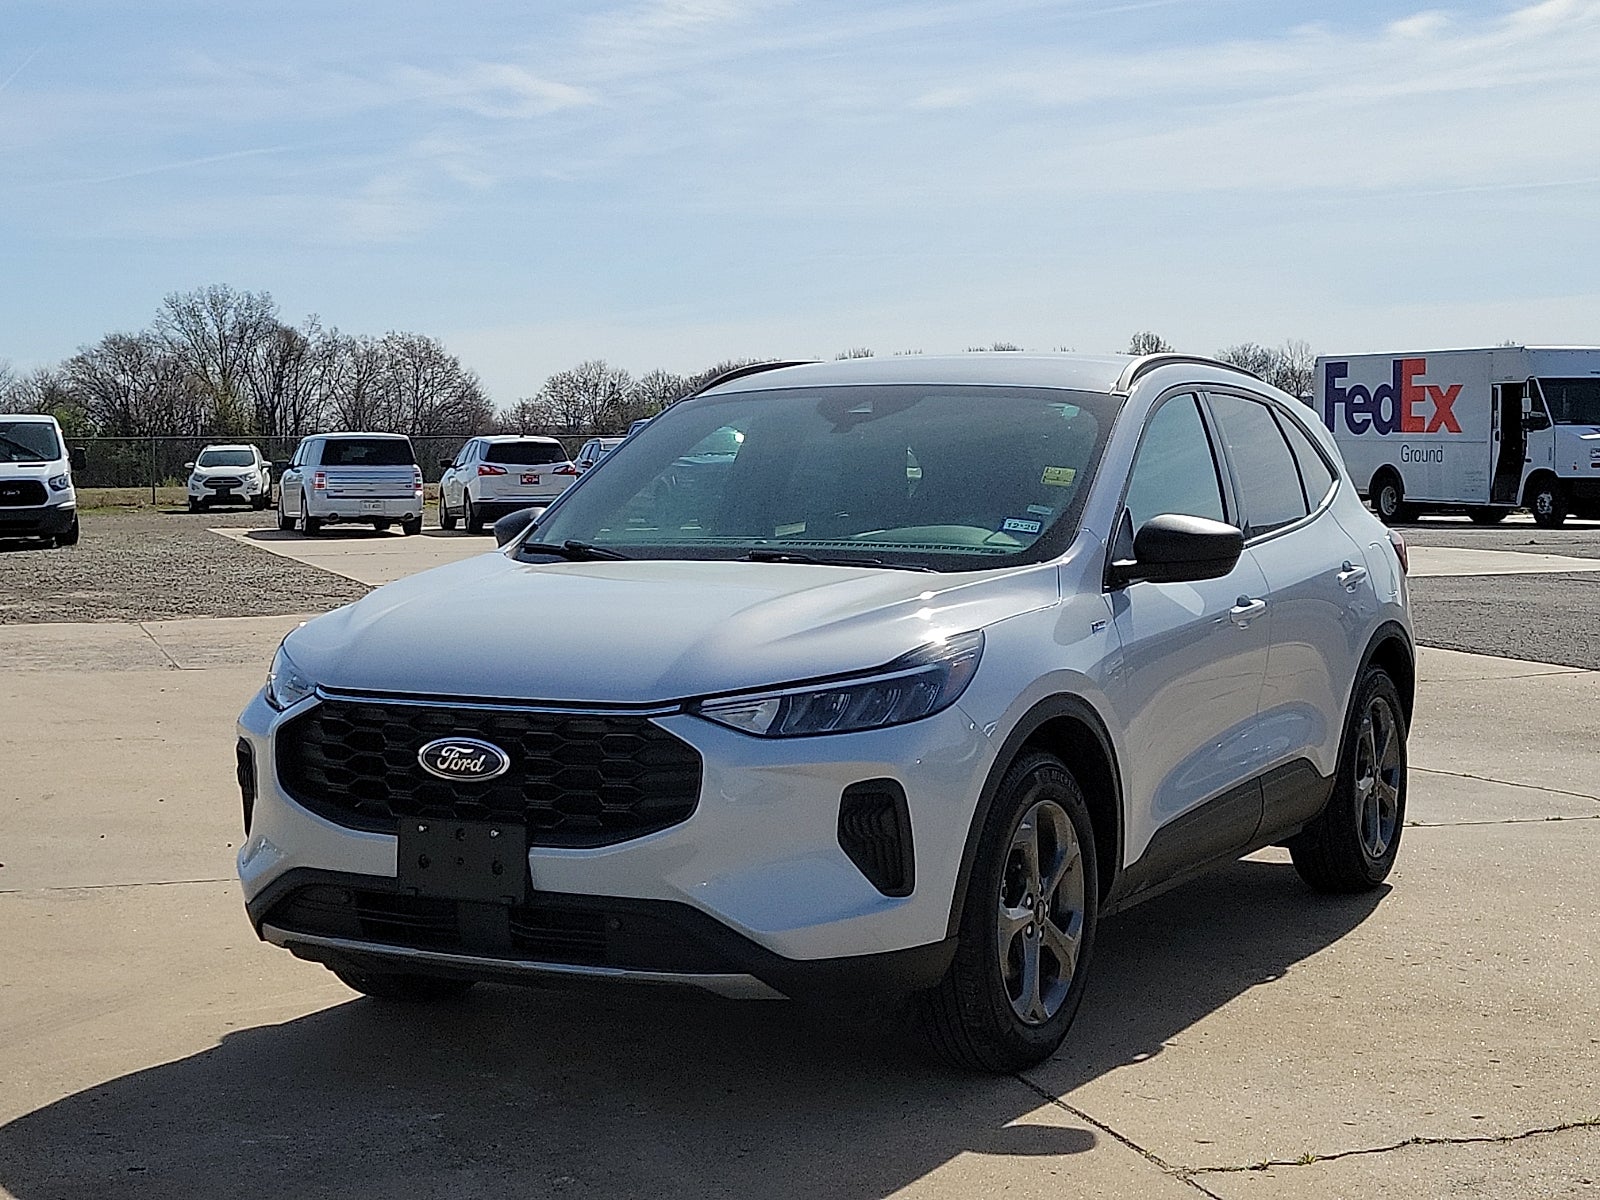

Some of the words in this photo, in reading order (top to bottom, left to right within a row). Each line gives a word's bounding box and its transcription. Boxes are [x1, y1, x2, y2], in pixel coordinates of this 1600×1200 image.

[1325, 358, 1463, 435] FedEx
[1401, 444, 1443, 463] Ground
[437, 746, 486, 772] Ford
